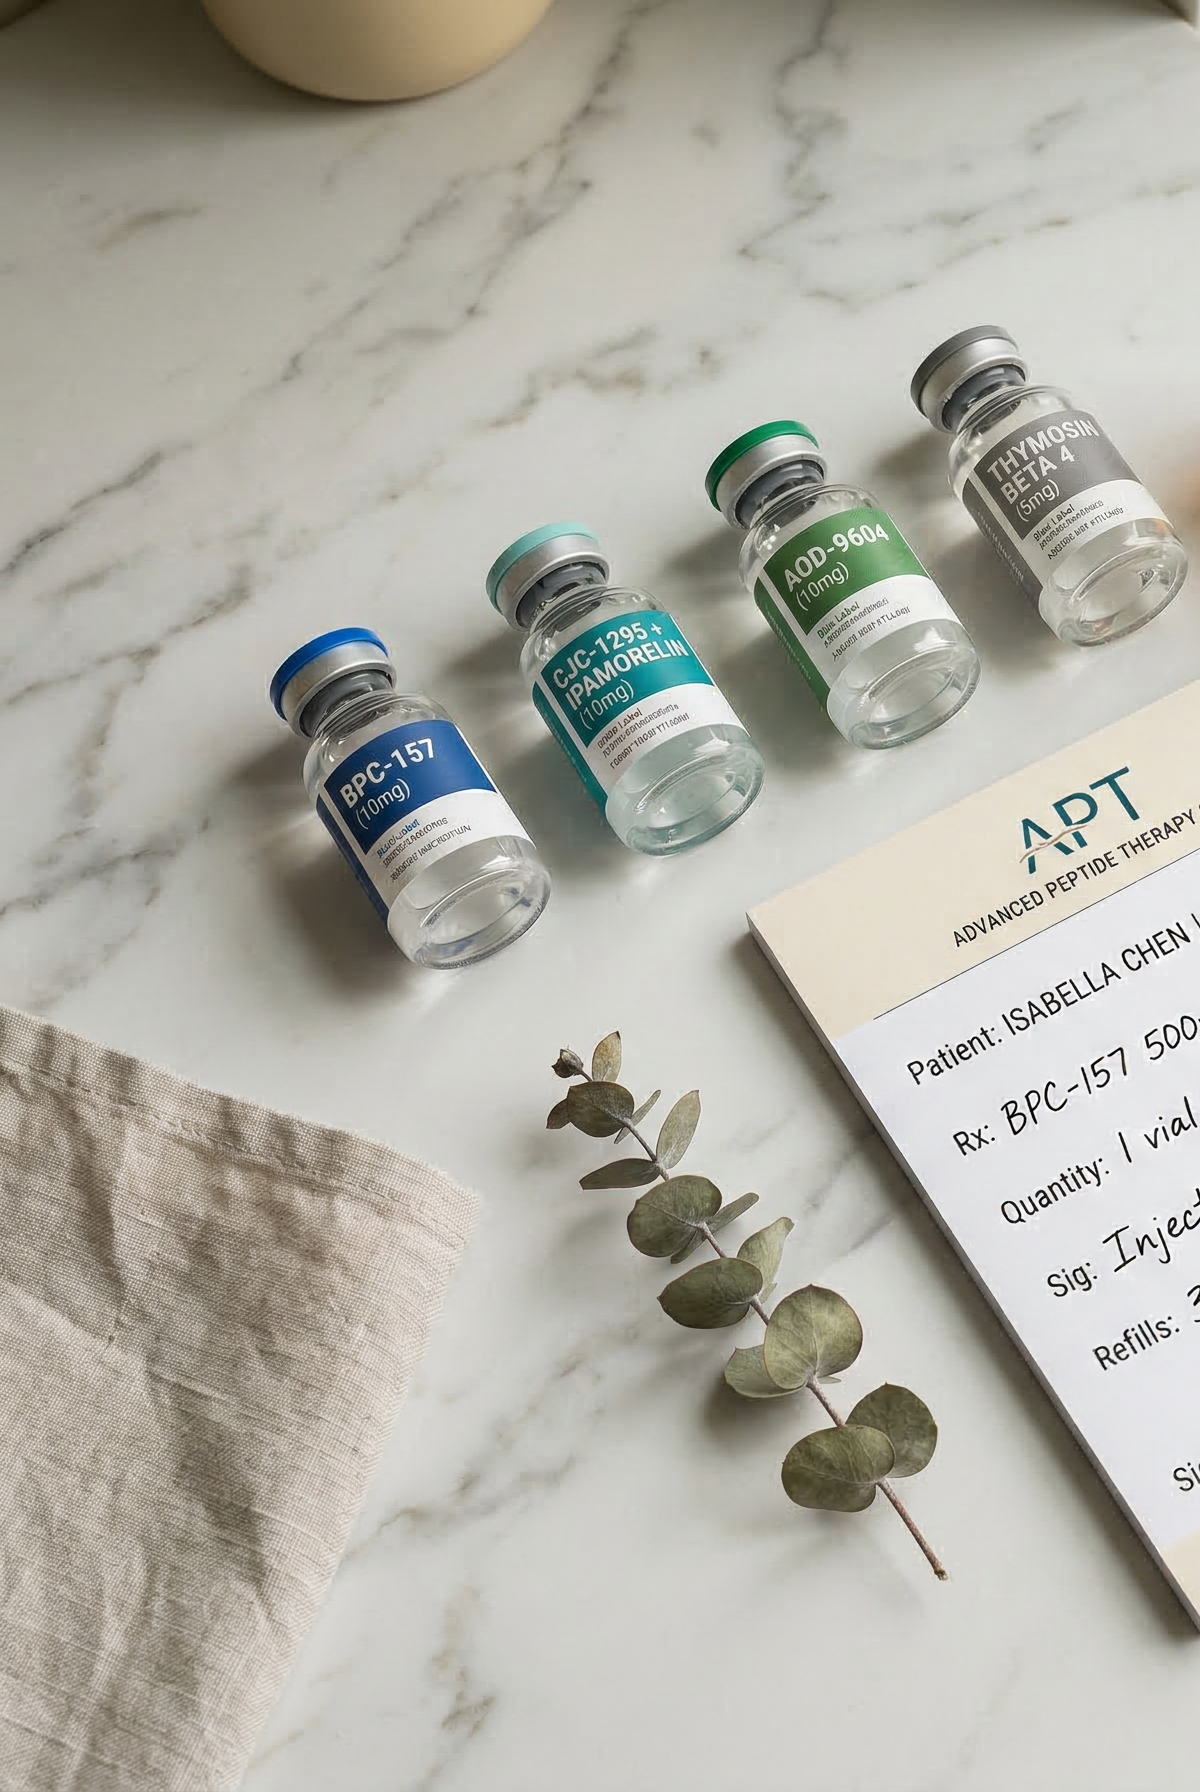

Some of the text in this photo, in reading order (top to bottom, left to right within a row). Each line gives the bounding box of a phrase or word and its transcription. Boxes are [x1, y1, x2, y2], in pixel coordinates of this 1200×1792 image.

[986, 418, 1099, 483] THYMOSIN
[1000, 445, 1075, 505] BETA 4
[1016, 479, 1060, 523] (5mg)
[783, 523, 890, 592] AOD-9604
[796, 561, 850, 612] (10mg)
[552, 622, 662, 690] CJC-1295 +
[565, 638, 689, 710] IPAMORELIN
[580, 678, 635, 731] (10mg)
[339, 737, 435, 809] BPC-157
[353, 778, 412, 831] (10mg)
[1021, 766, 1140, 875] APT
[953, 890, 1045, 948] ADVANCED
[1045, 850, 1119, 899] PEPTIDE
[1117, 808, 1197, 860] THERAPY
[907, 1027, 1002, 1085] Patient:
[1001, 962, 1121, 1035] ISABELLA
[1121, 922, 1190, 972] CHEN
[953, 1124, 996, 1156] Rx:
[1001, 1047, 1128, 1136] BPC-157
[1000, 1158, 1110, 1225] Quantity:
[1143, 1095, 1198, 1150] vial
[1046, 1262, 1098, 1298] Sig:
[1092, 1315, 1180, 1371] Refills:
